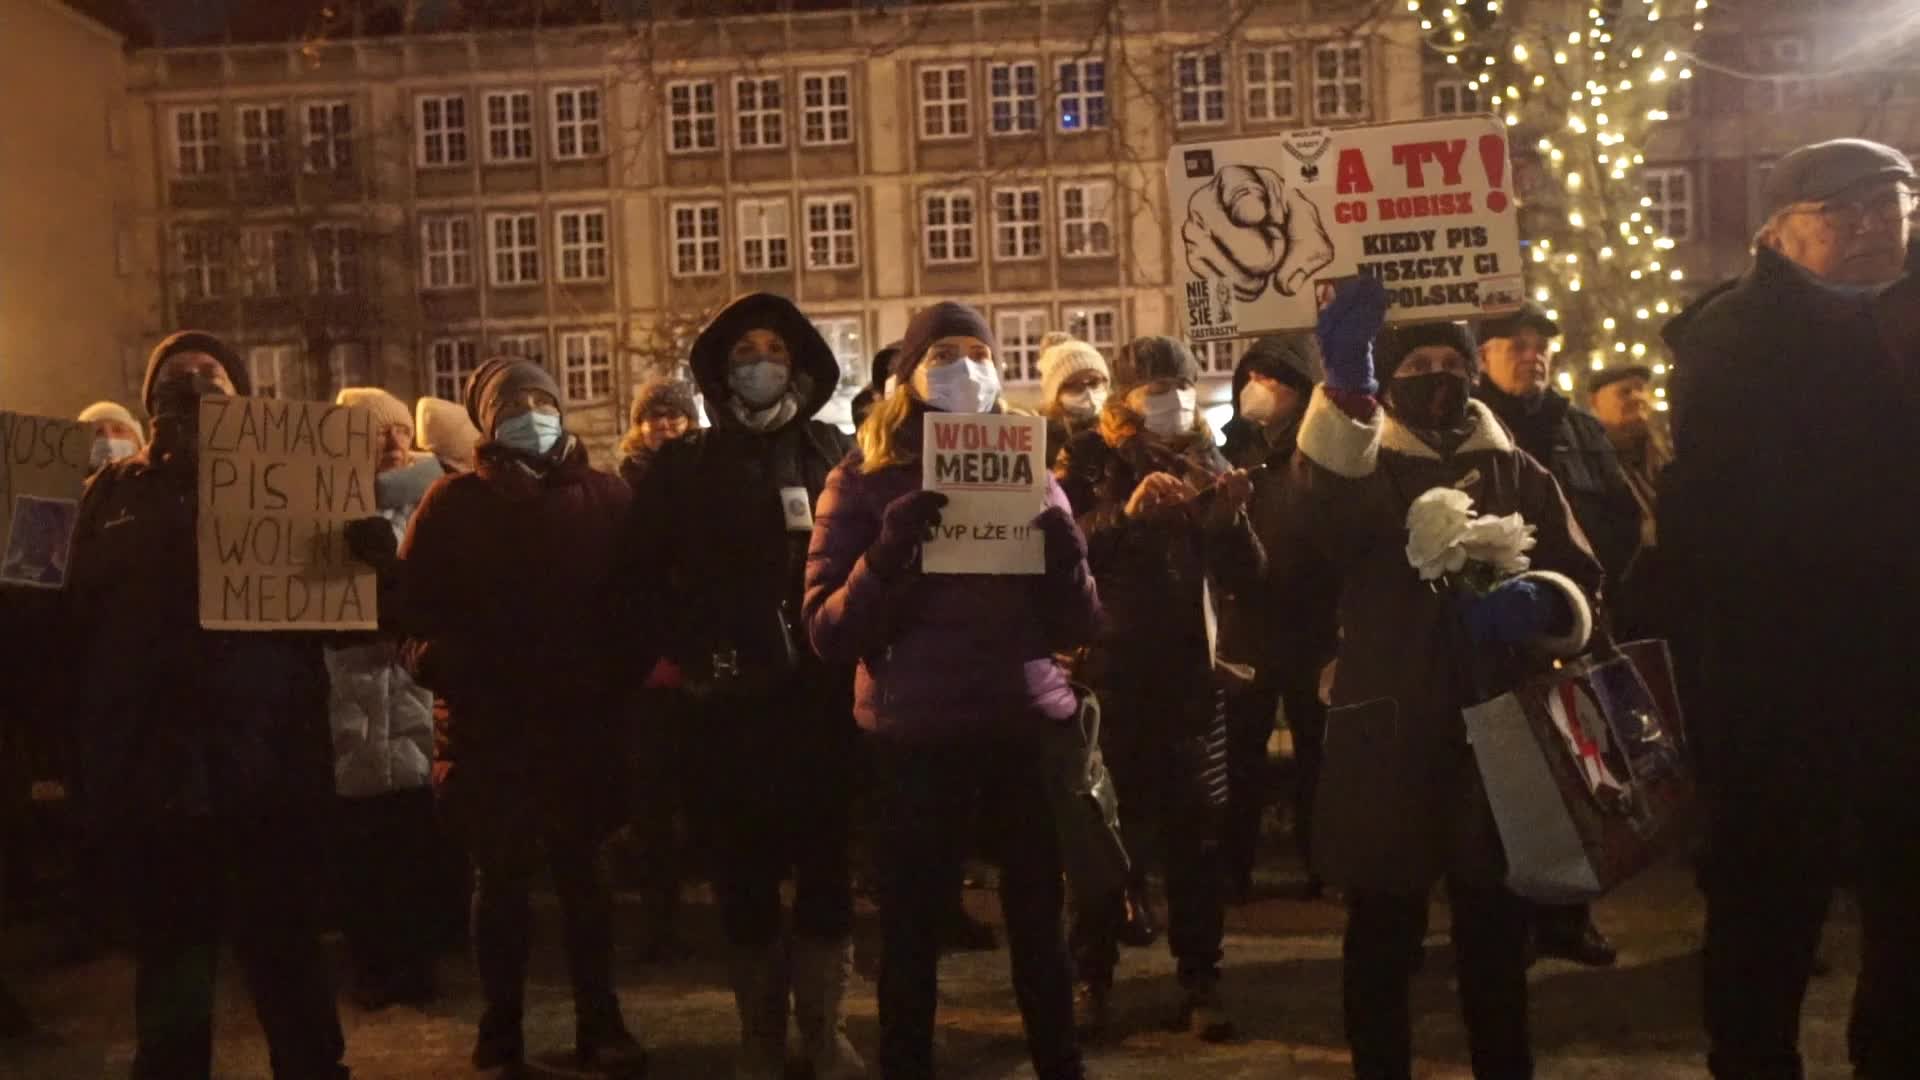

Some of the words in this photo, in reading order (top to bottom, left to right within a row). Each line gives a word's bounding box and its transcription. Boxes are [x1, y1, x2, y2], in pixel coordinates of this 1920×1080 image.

[1336, 149, 1373, 194] A
[1392, 139, 1467, 189] TY
[1334, 201, 1368, 224] CO
[1377, 192, 1473, 222] ROBISZ
[1362, 230, 1436, 256] KIEDY
[1447, 226, 1488, 249] PIS
[1473, 253, 1500, 274] CI
[1186, 280, 1209, 297] NIE
[203, 401, 370, 458] ZAMACH
[934, 422, 1033, 451] WOLNE
[935, 453, 1034, 484] MEDIA
[210, 458, 289, 512] PIS
[315, 465, 366, 512] NA
[222, 575, 365, 623] MEDIA
